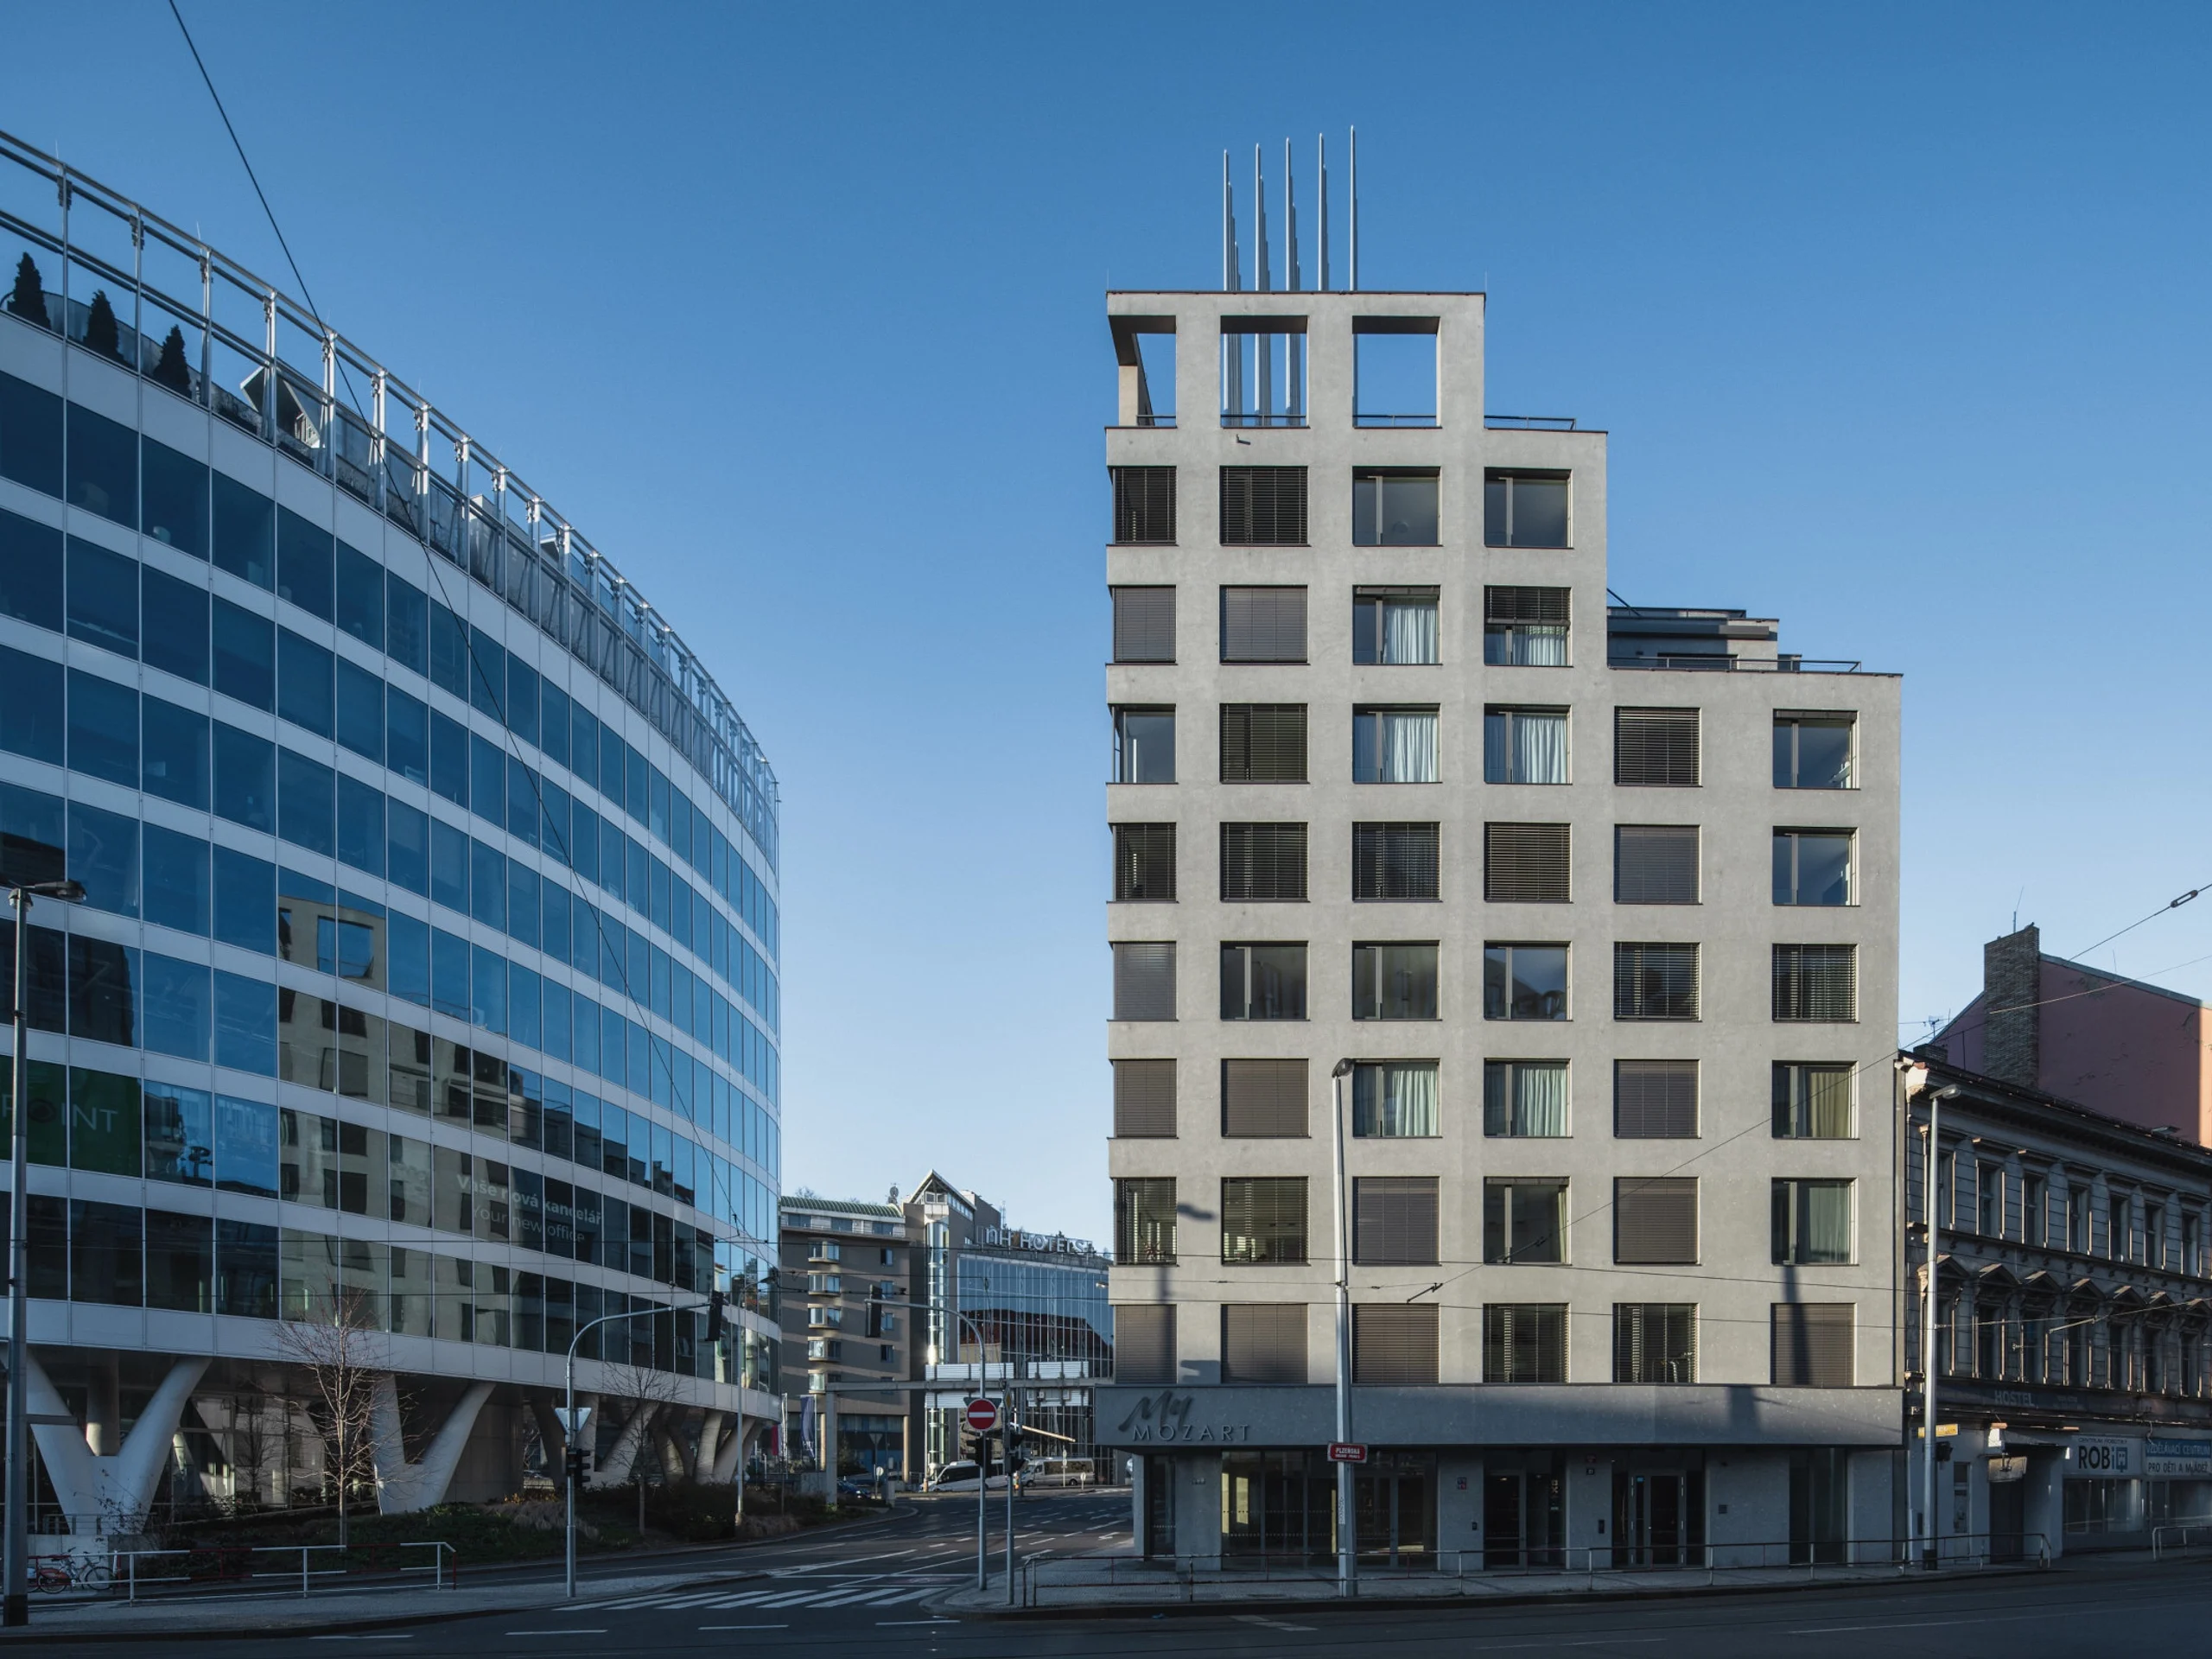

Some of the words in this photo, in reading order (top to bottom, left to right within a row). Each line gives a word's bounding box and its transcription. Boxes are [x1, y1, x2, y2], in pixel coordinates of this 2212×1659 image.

[512, 1217, 543, 1233] new
[1993, 1389, 2035, 1408] HOSTEL
[1117, 1389, 1194, 1433] My
[1132, 1423, 1249, 1441] MOZART
[2148, 1462, 2161, 1472] PRO
[2178, 1463, 2183, 1472] A
